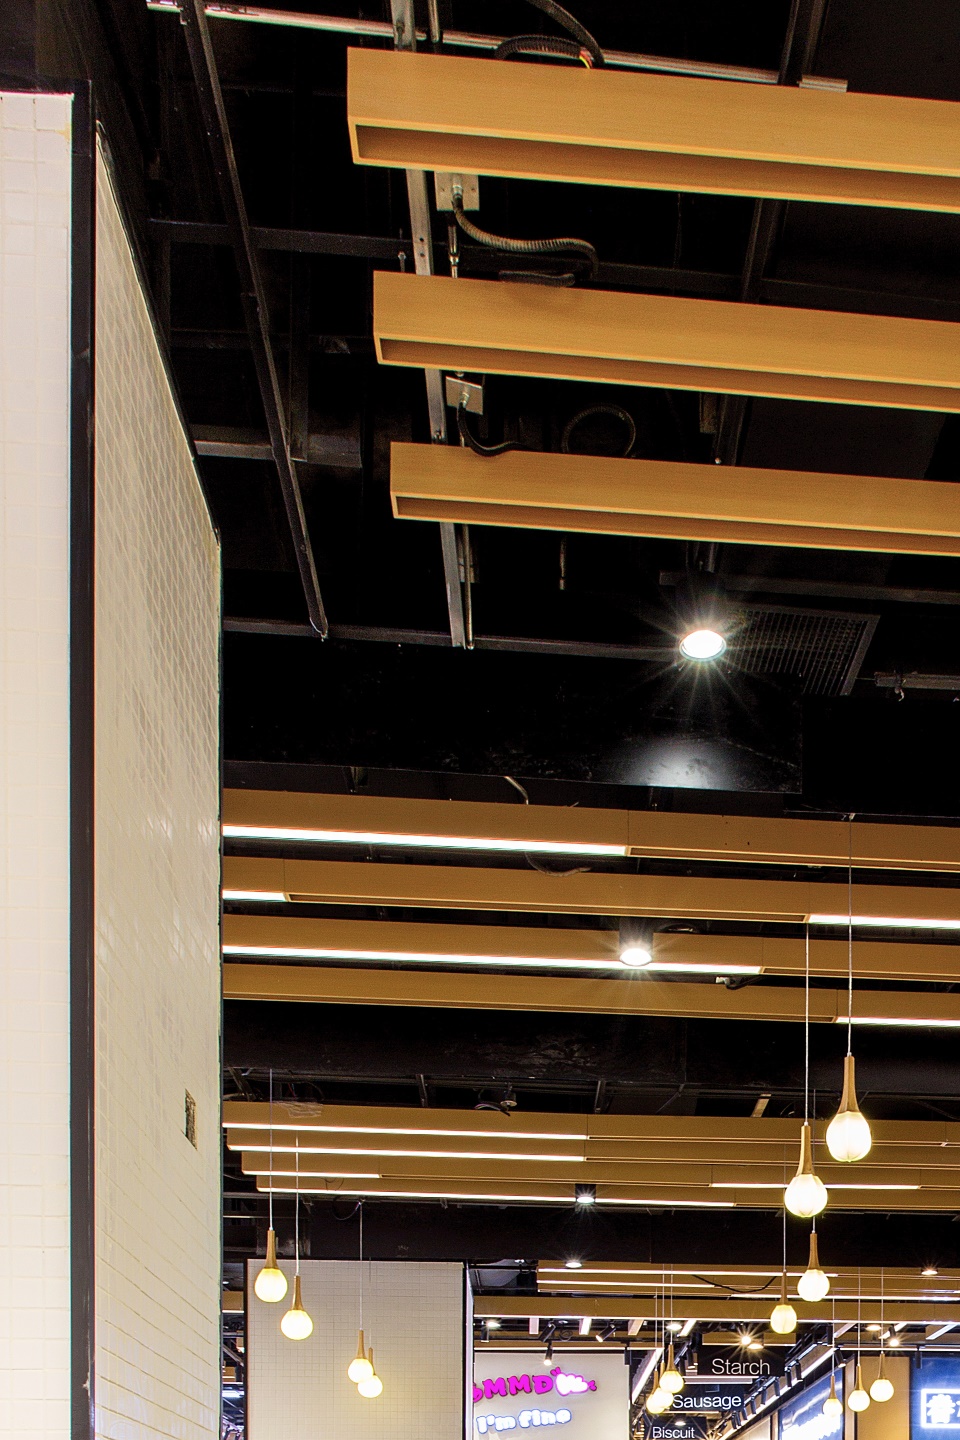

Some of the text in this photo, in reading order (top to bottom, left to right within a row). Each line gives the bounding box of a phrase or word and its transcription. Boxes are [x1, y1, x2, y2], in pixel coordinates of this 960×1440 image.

[711, 1358, 770, 1375] Starch
[672, 1395, 742, 1410] Sausage
[476, 1414, 516, 1434] I'm
[652, 1426, 695, 1439] Biscuit
